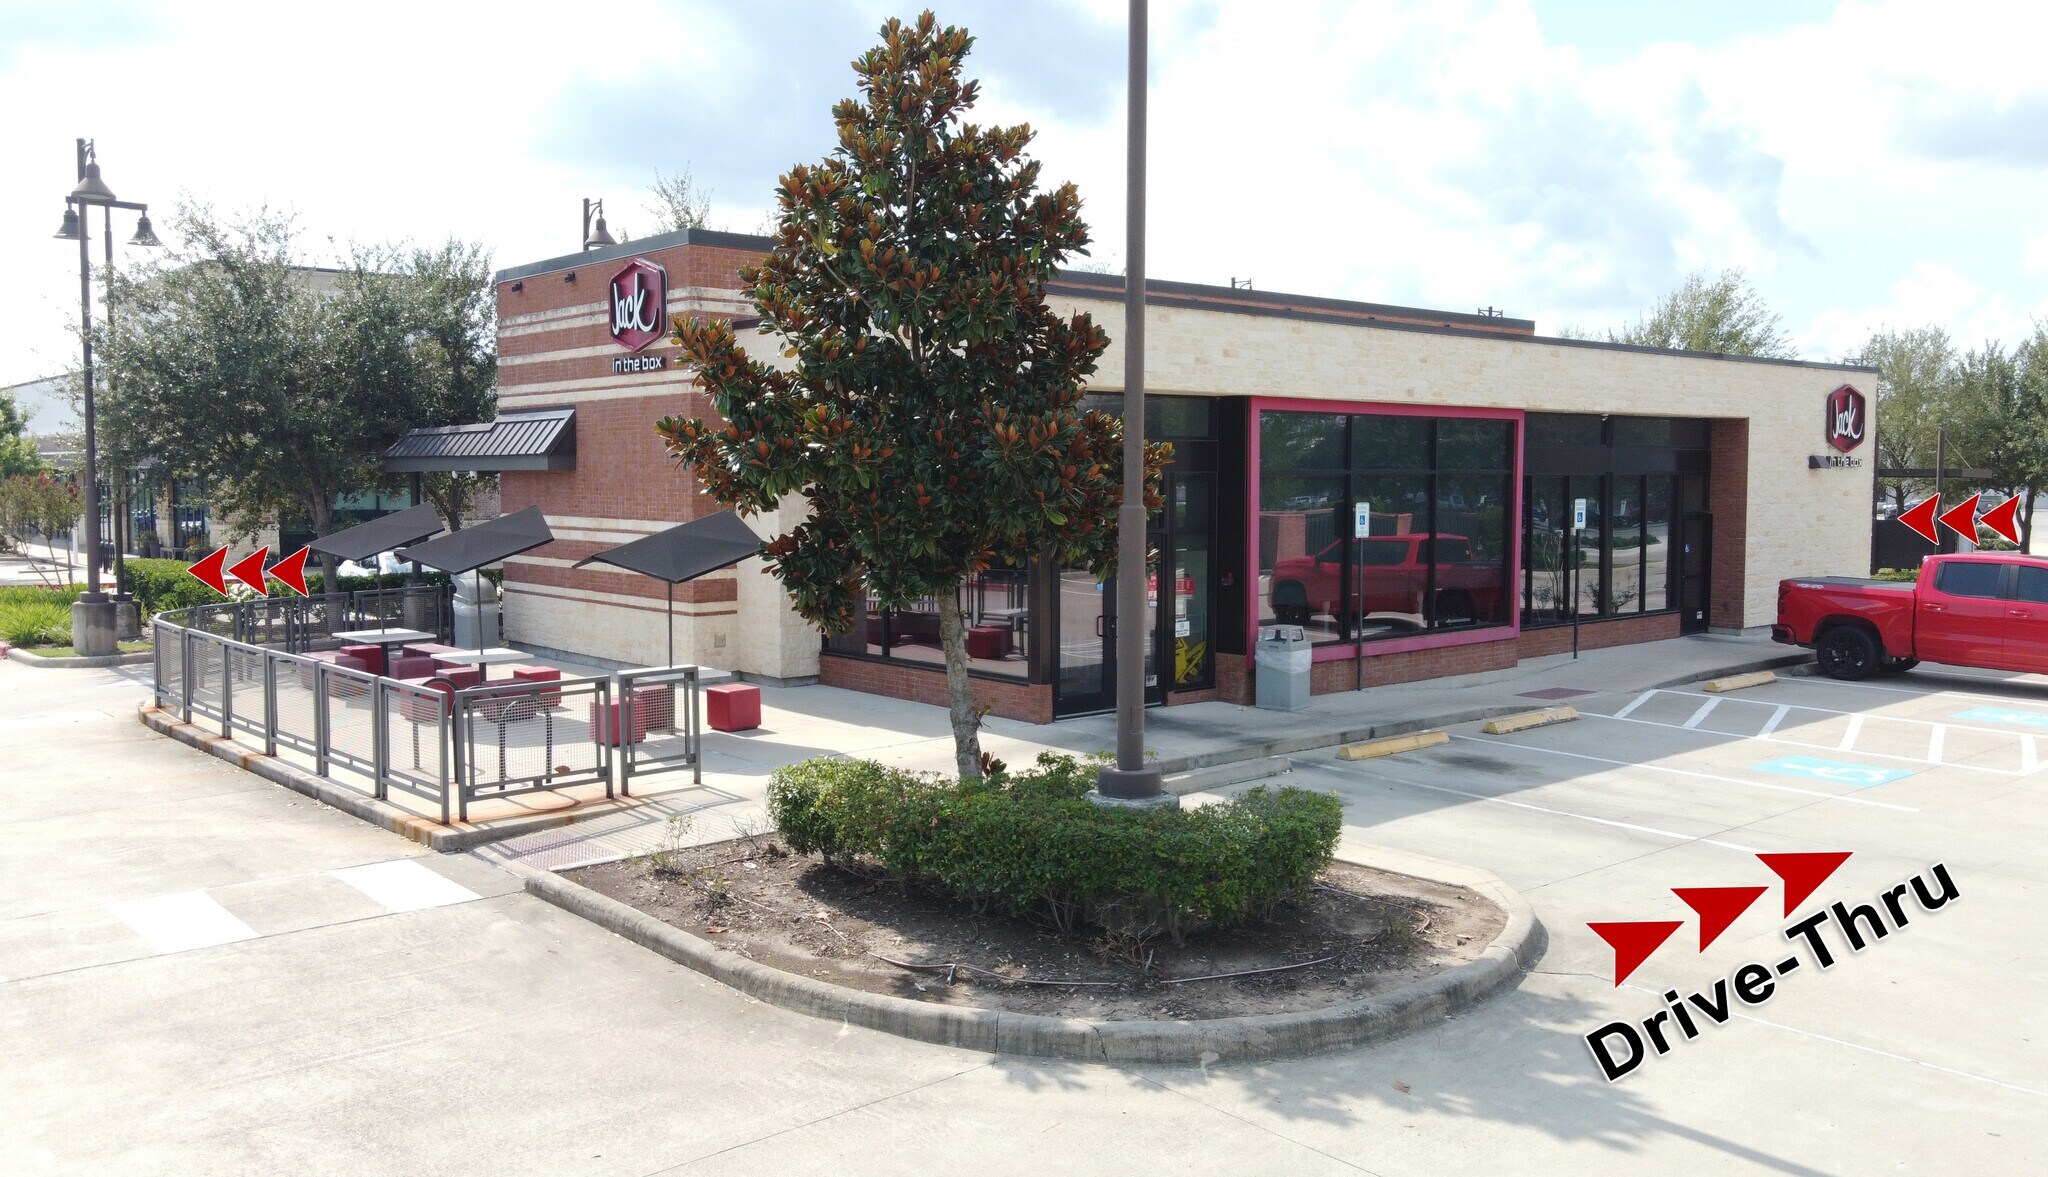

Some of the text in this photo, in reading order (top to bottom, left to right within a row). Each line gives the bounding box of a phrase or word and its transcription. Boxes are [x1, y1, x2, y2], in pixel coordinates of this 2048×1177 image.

[611, 272, 659, 335] Jack
[612, 355, 662, 373] in the box
[1832, 394, 1863, 439] Jack
